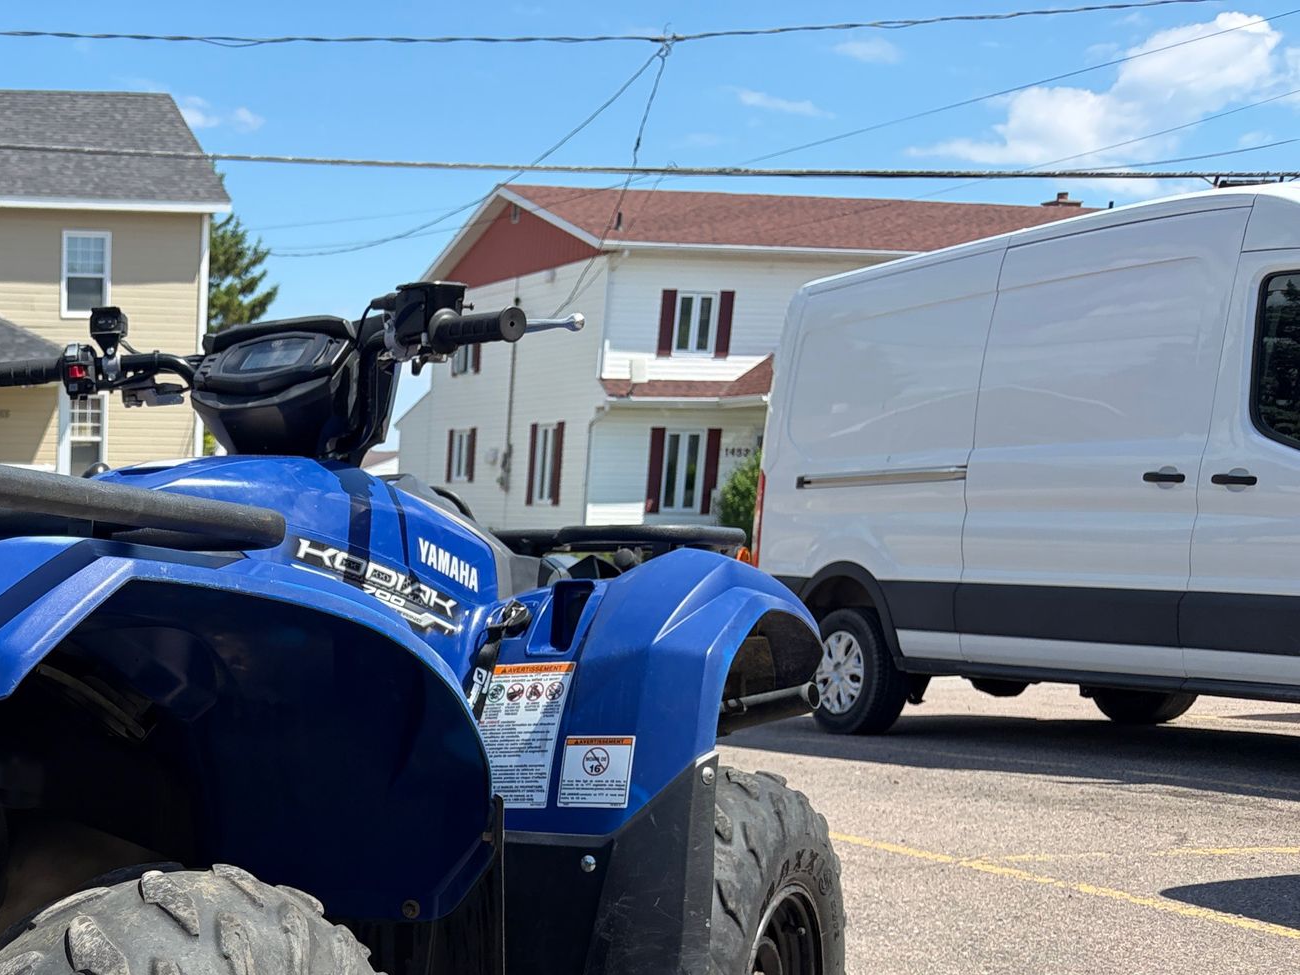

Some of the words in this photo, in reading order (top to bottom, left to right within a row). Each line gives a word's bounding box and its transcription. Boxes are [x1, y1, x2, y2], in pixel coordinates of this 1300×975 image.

[296, 538, 458, 618] KODIAK
[418, 537, 479, 593] YAMAHA
[507, 664, 563, 674] AVERTISSEMENT
[589, 764, 601, 773] 16
